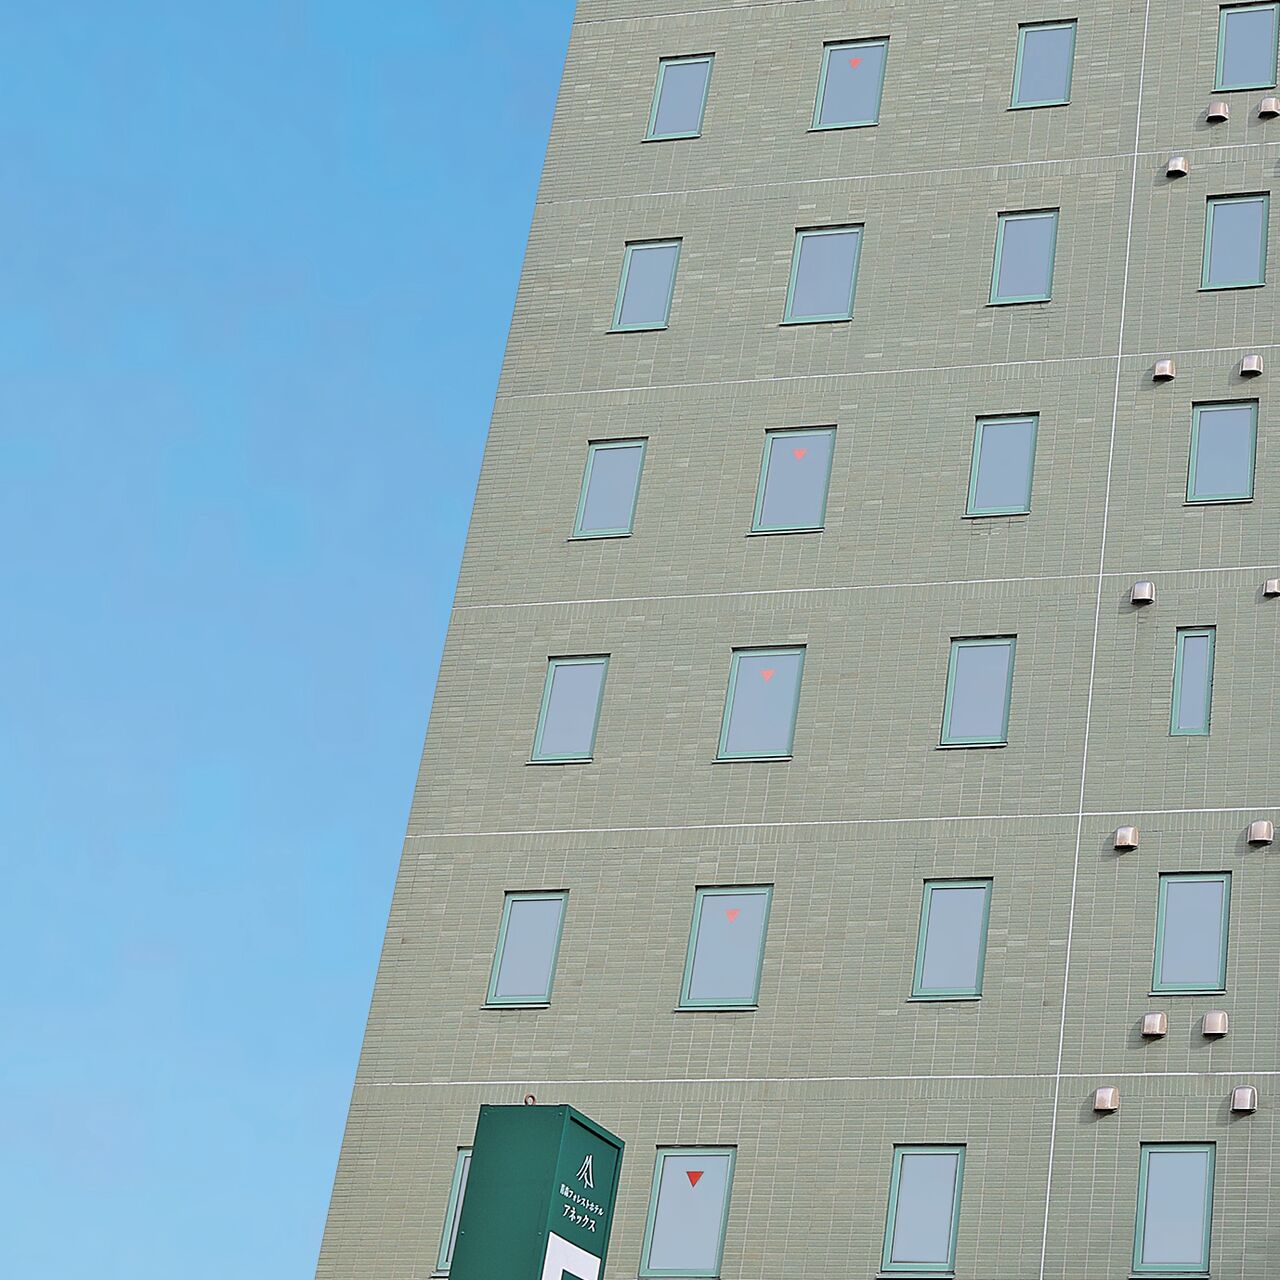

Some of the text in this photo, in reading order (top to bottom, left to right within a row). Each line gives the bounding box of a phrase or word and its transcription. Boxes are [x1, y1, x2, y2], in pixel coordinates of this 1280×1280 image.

[563, 1204, 596, 1232] アネックス
